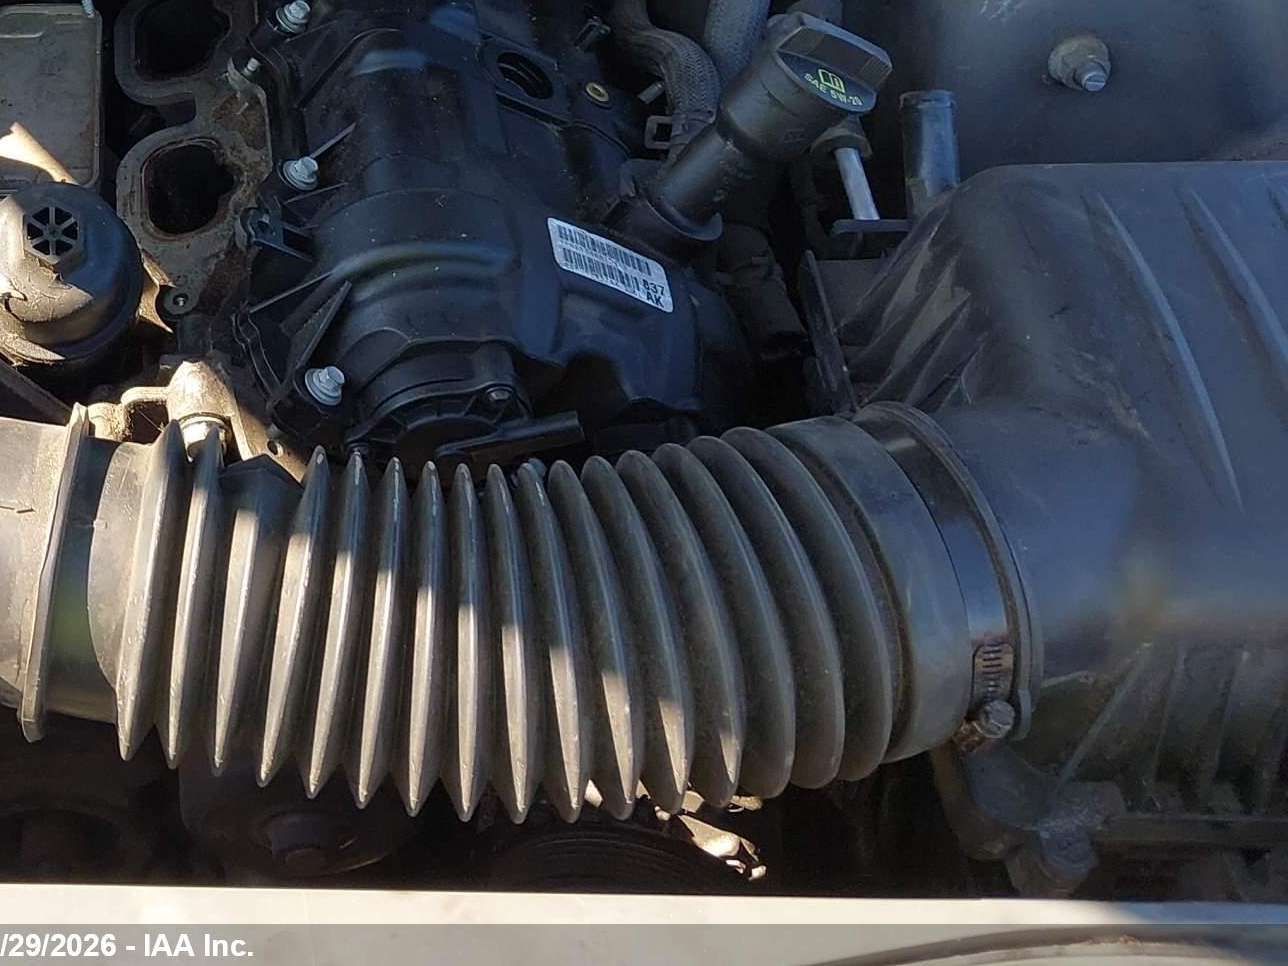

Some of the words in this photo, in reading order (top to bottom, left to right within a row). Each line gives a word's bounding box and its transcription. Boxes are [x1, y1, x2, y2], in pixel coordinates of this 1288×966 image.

[804, 73, 827, 94] SAE
[830, 88, 863, 106] 5W-20
[646, 291, 665, 308] AK
